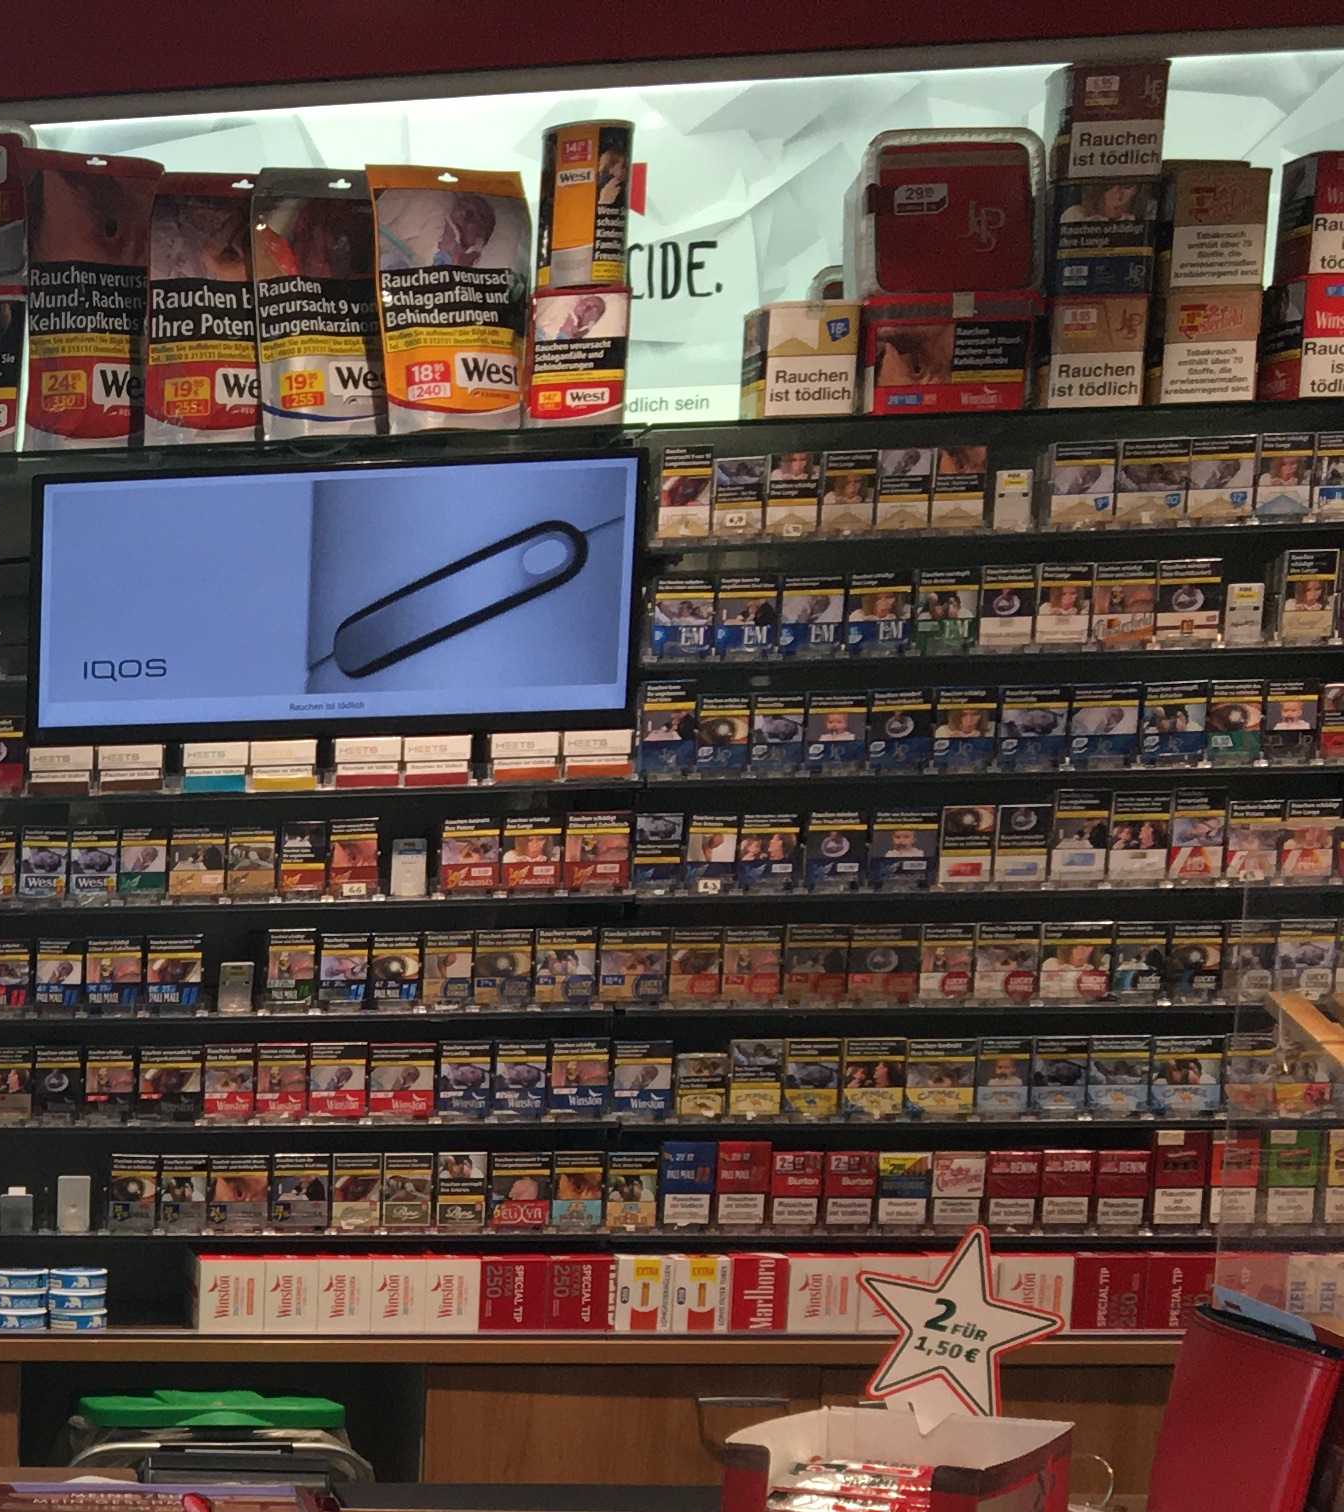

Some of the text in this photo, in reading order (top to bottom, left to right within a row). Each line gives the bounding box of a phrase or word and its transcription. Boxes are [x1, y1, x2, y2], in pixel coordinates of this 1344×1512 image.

[559, 170, 591, 183] West
[382, 271, 449, 288] Rauchen
[152, 288, 238, 309] Rauchen
[385, 308, 499, 327] Behinderungen
[152, 316, 194, 338] Ihre
[775, 369, 848, 384] Rauchen
[1058, 363, 1135, 378] Rauchen
[570, 391, 605, 402] West
[769, 386, 851, 402] ist tödlich
[1051, 382, 1138, 397] ist tödlich
[674, 395, 709, 410] sein
[83, 657, 167, 682] IQOS
[289, 702, 325, 713] Rauchen
[512, 1265, 523, 1303] SPECIAL
[214, 1274, 231, 1318] Winston
[748, 1259, 775, 1330] Marlboro
[925, 1297, 987, 1343] 2 FÜR
[913, 1336, 980, 1363] 1,50 €
